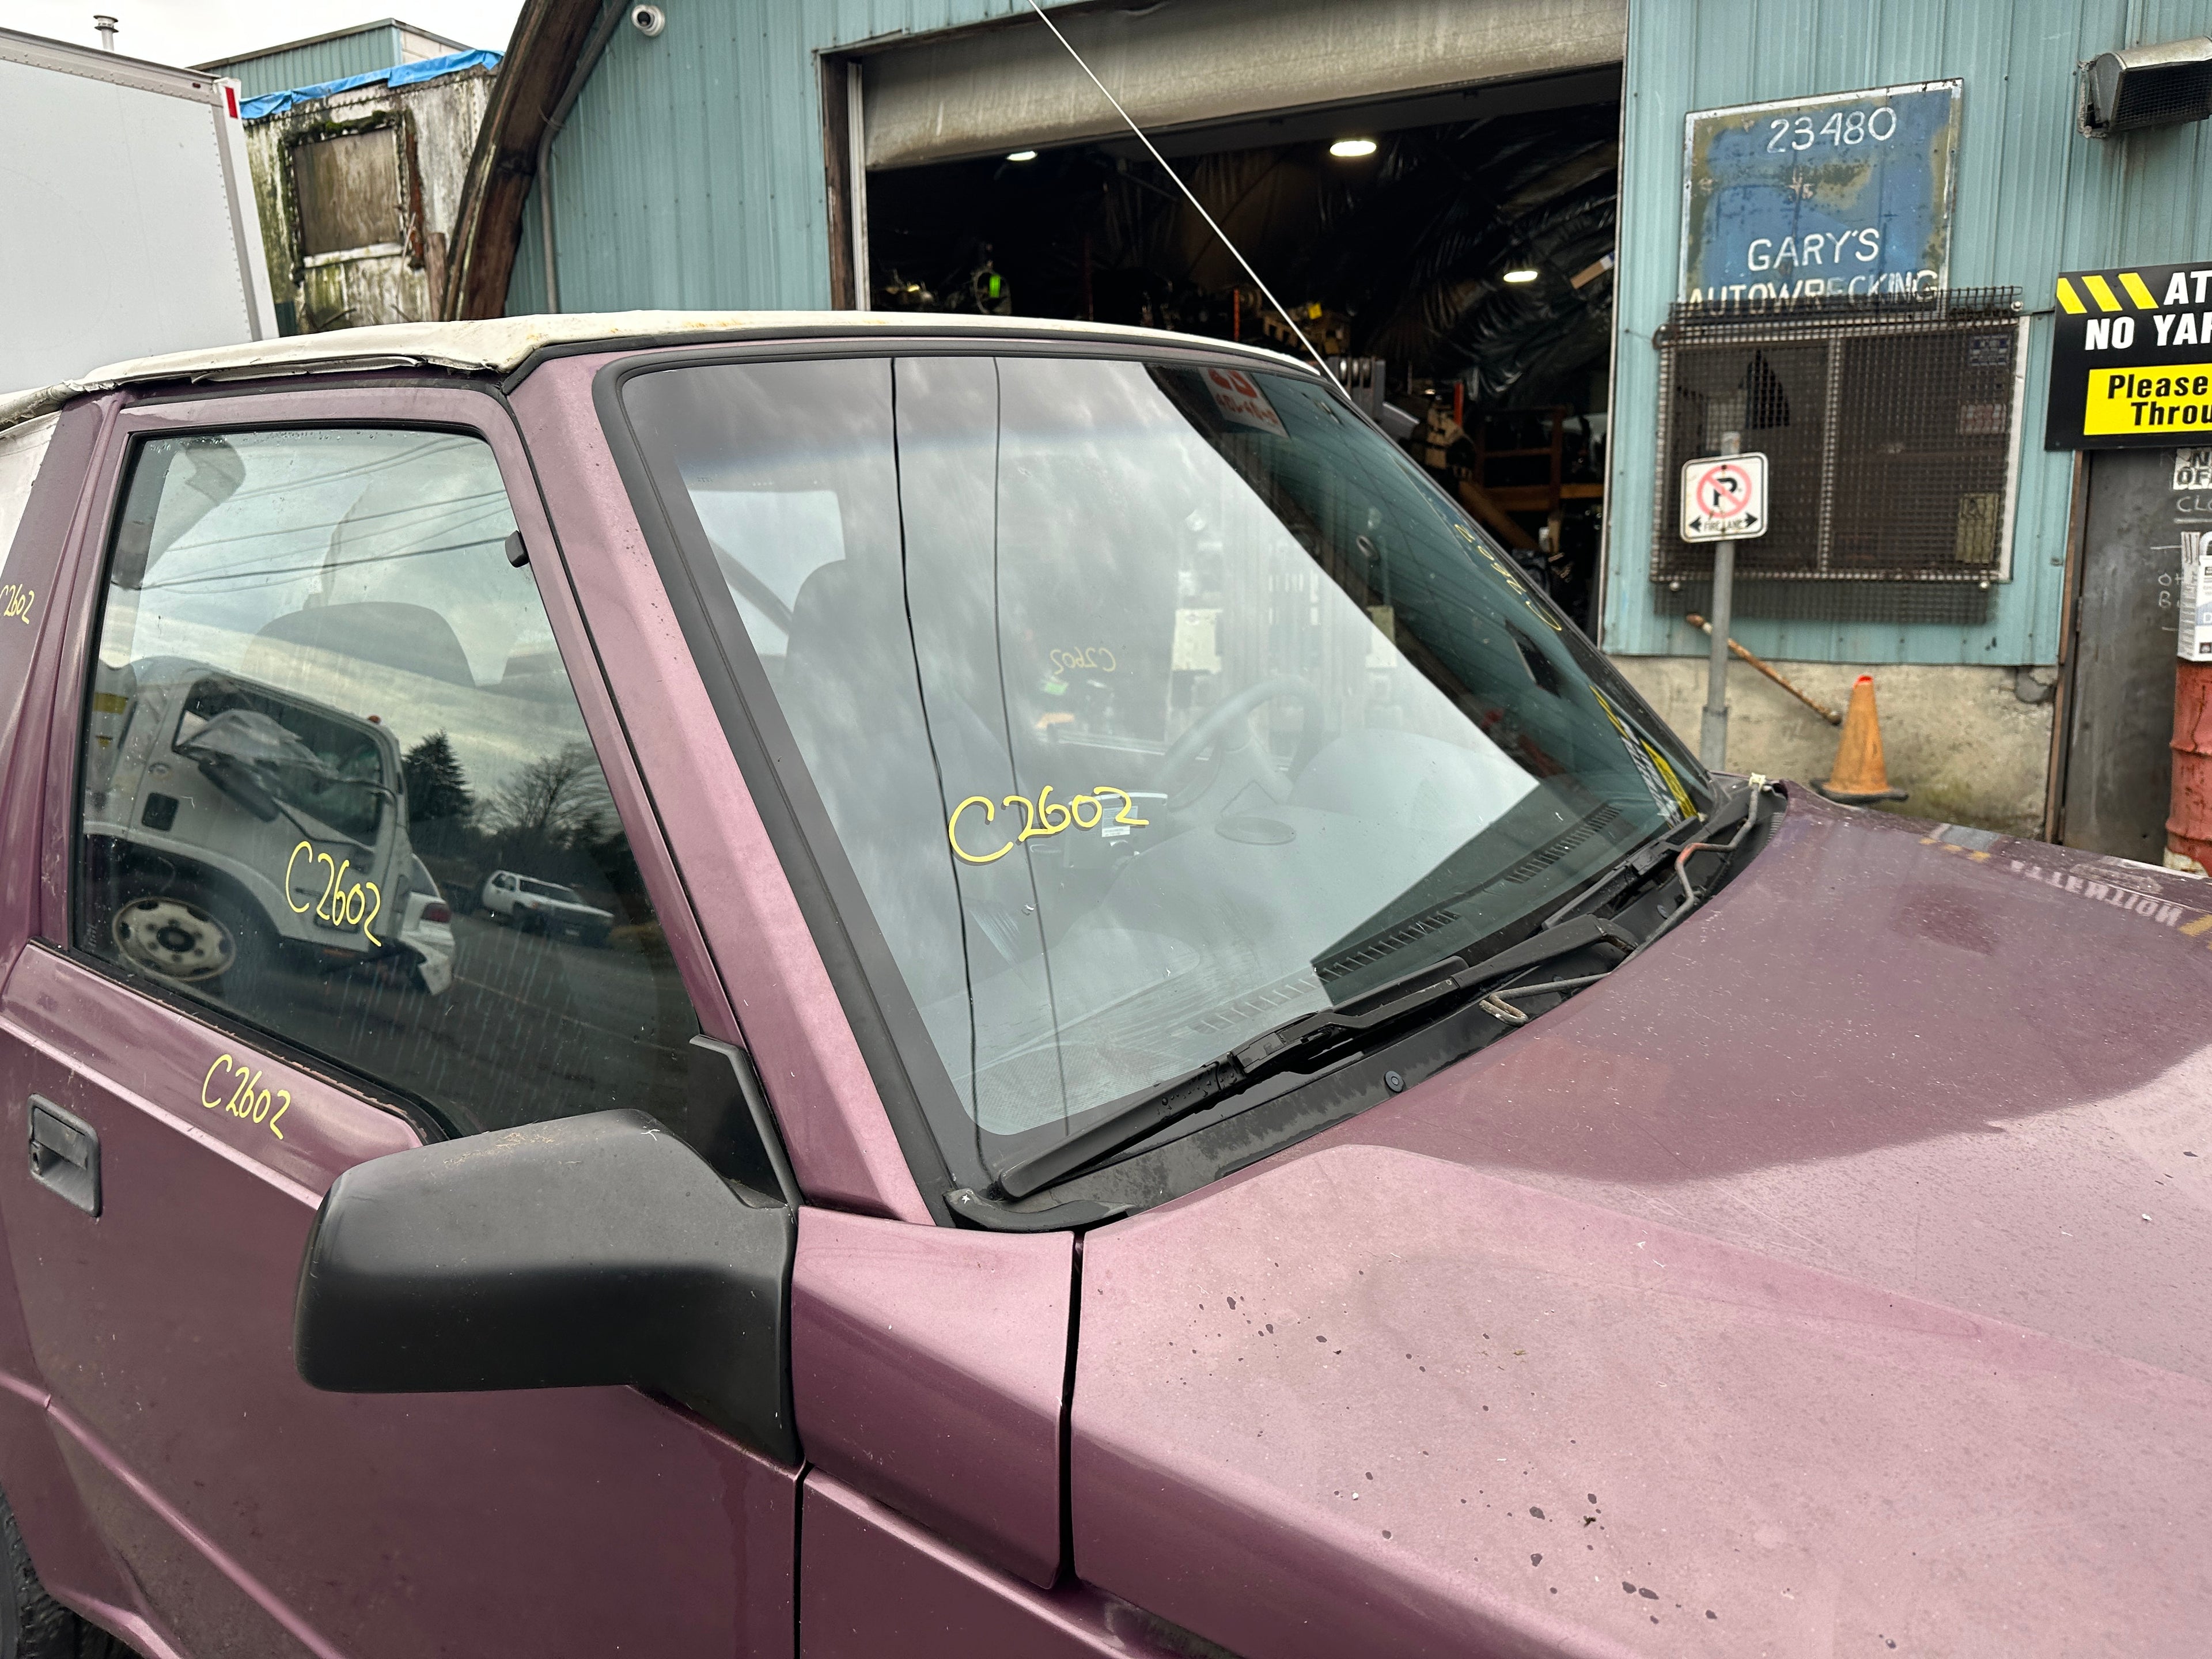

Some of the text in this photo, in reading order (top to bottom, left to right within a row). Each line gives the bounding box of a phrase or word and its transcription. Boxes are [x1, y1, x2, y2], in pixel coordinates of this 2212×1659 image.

[1767, 107, 1897, 154] 23480
[1747, 228, 1880, 272] GARY'S
[2163, 270, 2212, 305] AT
[2084, 316, 2135, 351] NO
[2107, 373, 2209, 399] Please
[2176, 495, 2212, 513] CL
[948, 785, 1150, 863] C2602
[285, 840, 382, 947] C2602
[202, 1054, 291, 1140] C2602
